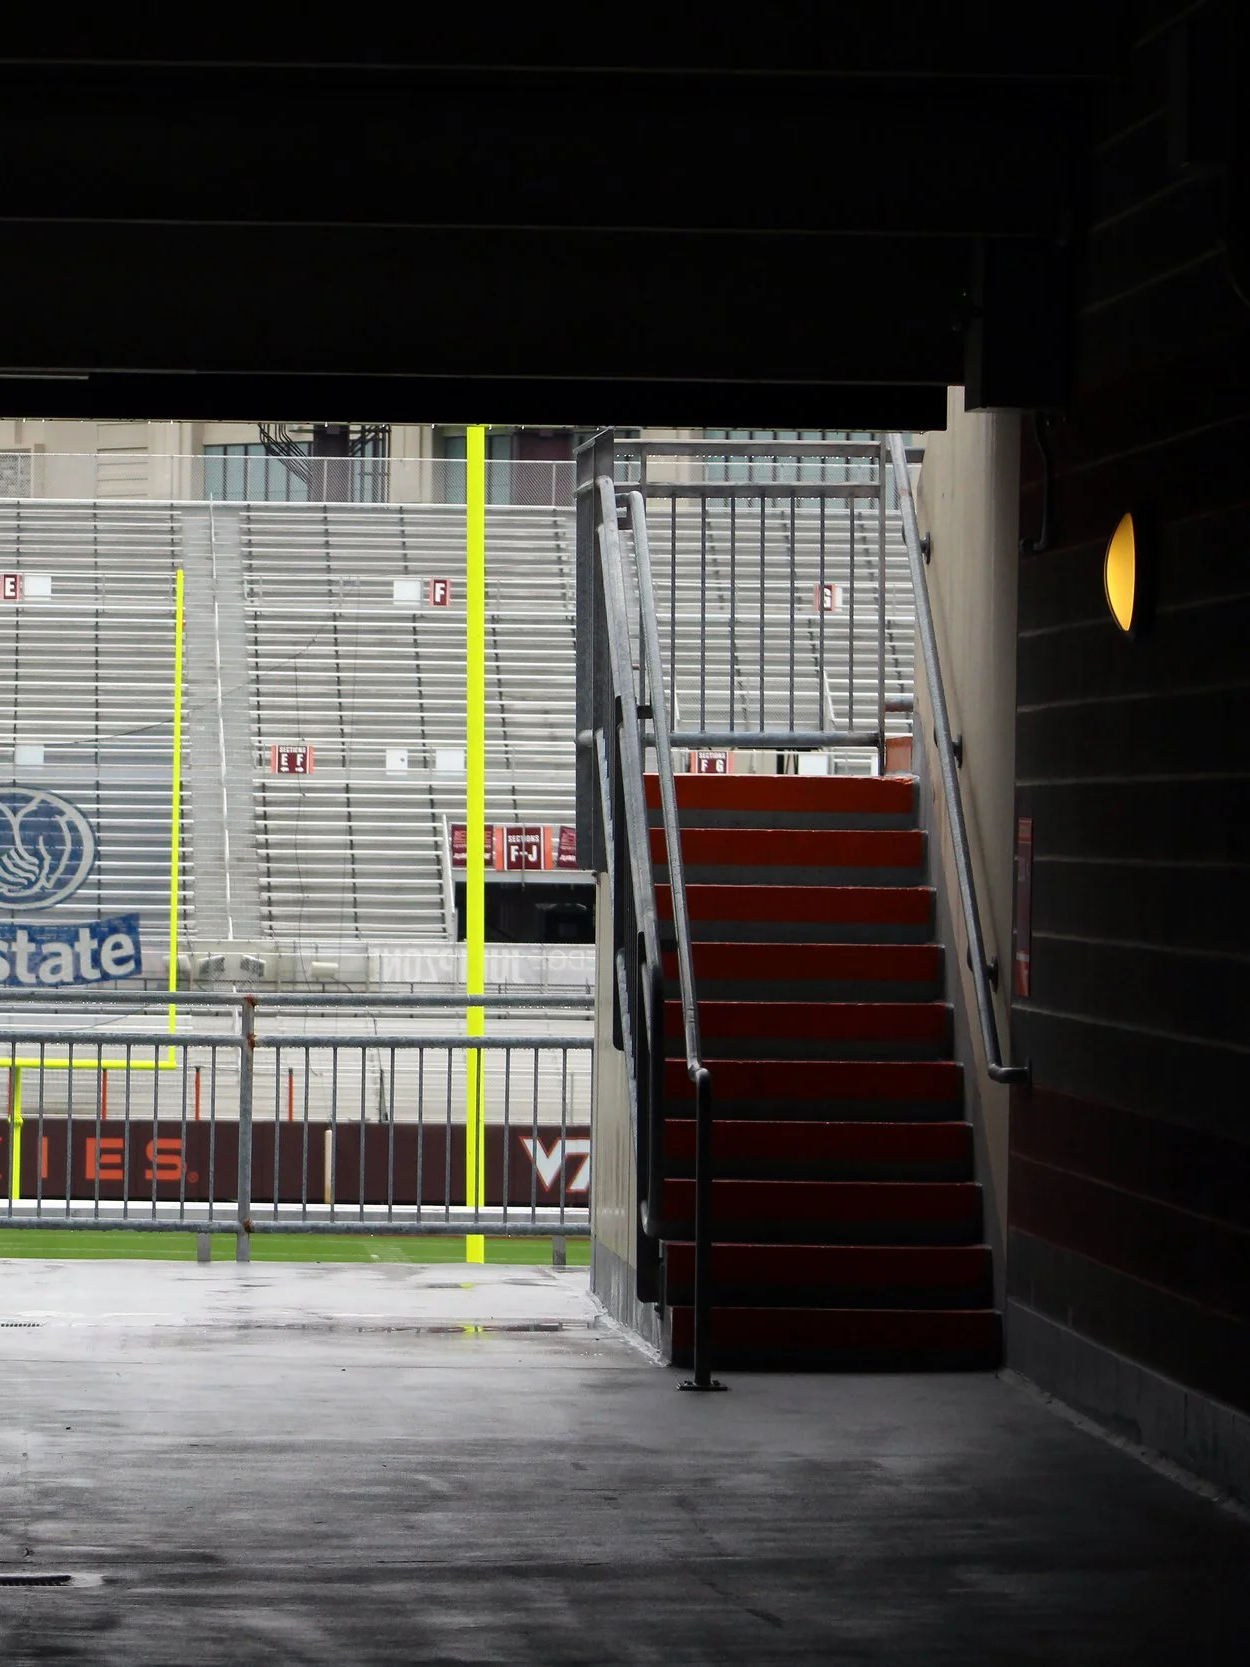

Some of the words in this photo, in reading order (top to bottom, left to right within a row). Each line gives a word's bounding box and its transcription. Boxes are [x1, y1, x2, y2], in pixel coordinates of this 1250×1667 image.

[5, 577, 16, 597] E
[435, 582, 446, 603] F
[281, 753, 289, 766] E
[296, 753, 304, 766] F
[701, 759, 708, 773] F
[716, 759, 724, 773] G
[507, 834, 540, 843] SECONS
